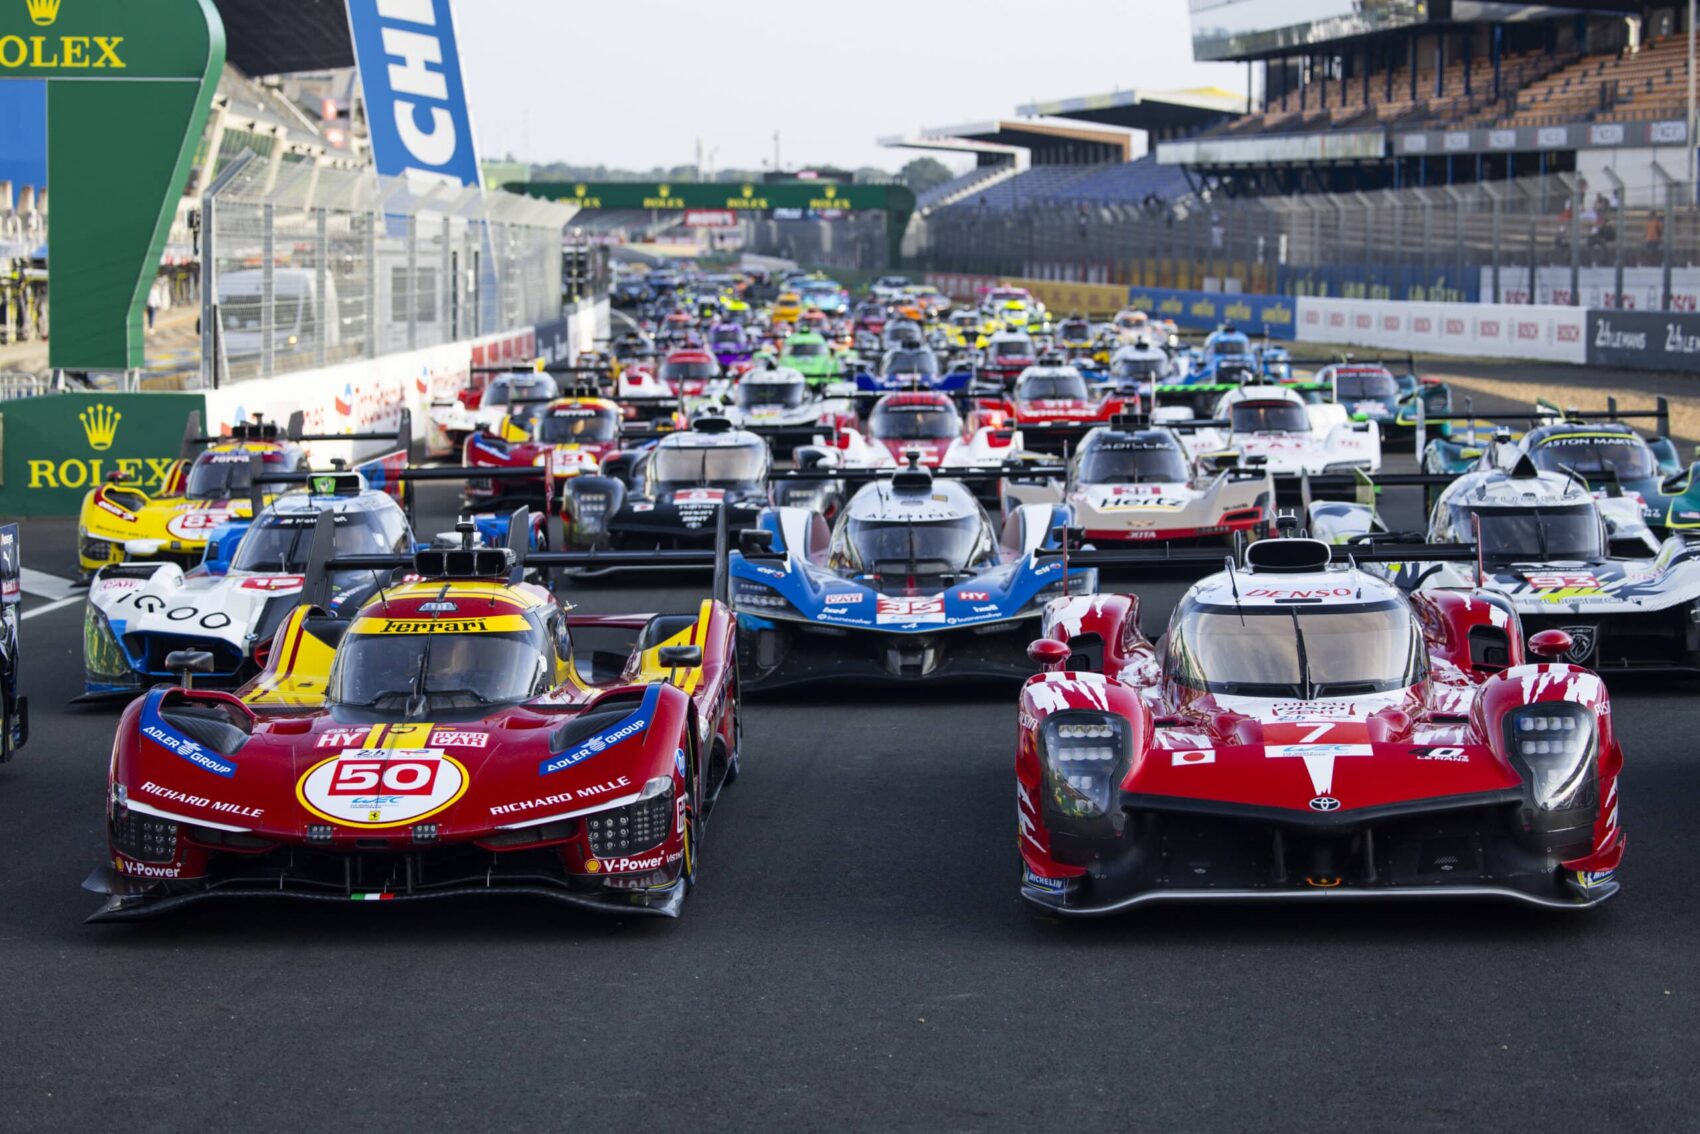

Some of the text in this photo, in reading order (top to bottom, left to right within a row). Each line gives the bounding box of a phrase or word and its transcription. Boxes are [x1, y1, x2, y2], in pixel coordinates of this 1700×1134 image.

[1544, 438, 1590, 448] ASTON
[28, 458, 172, 488] ROLEX
[1101, 497, 1184, 508] Hertz
[1530, 577, 1598, 588] 93
[960, 591, 986, 600] HY
[1246, 588, 1351, 598] DENSO
[379, 618, 488, 633] Ferrari
[317, 733, 361, 747] HY
[1296, 722, 1336, 743] 7
[435, 737, 482, 746] CAR
[547, 719, 645, 772] ADLER GROUP
[143, 725, 231, 775] ADLER GROUP
[335, 763, 432, 790] 50
[141, 781, 264, 818] RICHARD MILLE
[490, 775, 631, 815] RICHARD MILLE
[124, 861, 180, 878] V-Power
[604, 856, 663, 872] V-Power
[1028, 872, 1063, 888] MICHELIN
